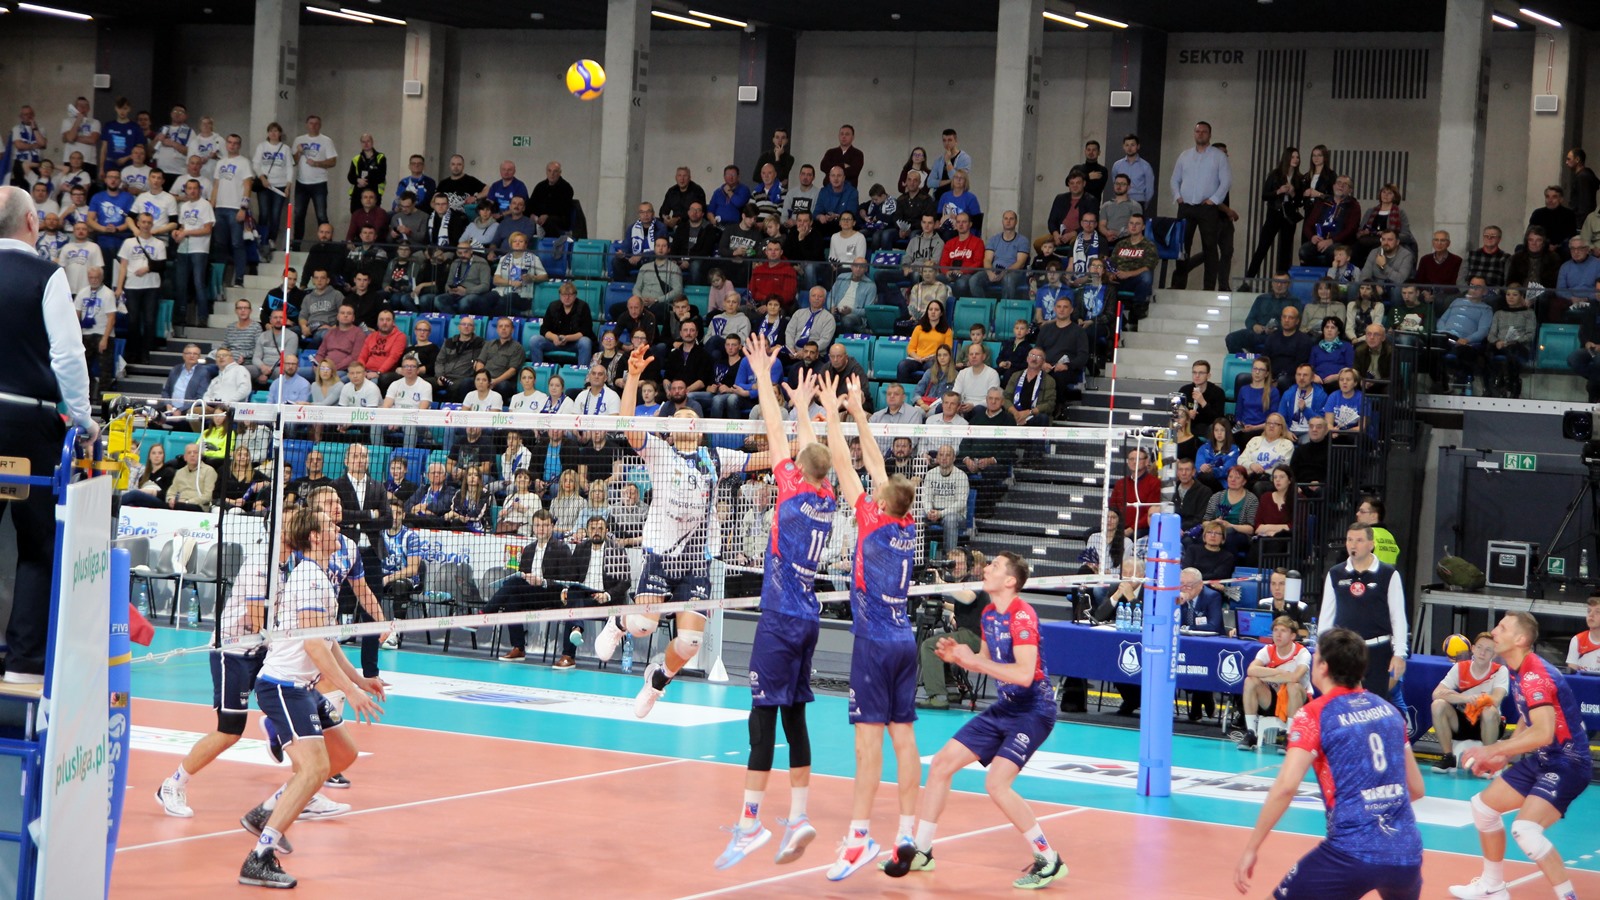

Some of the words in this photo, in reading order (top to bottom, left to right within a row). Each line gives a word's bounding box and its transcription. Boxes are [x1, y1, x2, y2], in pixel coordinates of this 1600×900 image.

[1179, 49, 1244, 64] SEKTOR
[238, 407, 254, 415] netex
[351, 409, 369, 422] plus
[492, 414, 508, 426] plus
[616, 418, 631, 429] plus
[726, 421, 739, 432] plus
[1257, 452, 1270, 462] 48
[688, 474, 697, 489] 9
[807, 529, 824, 561] 11
[72, 541, 109, 591] plusliga.pl
[899, 559, 908, 589] 1
[224, 637, 240, 645] netex
[1337, 704, 1394, 727] KALEMBKA
[1369, 732, 1388, 772] 8
[55, 733, 107, 795] plusliga.pl
